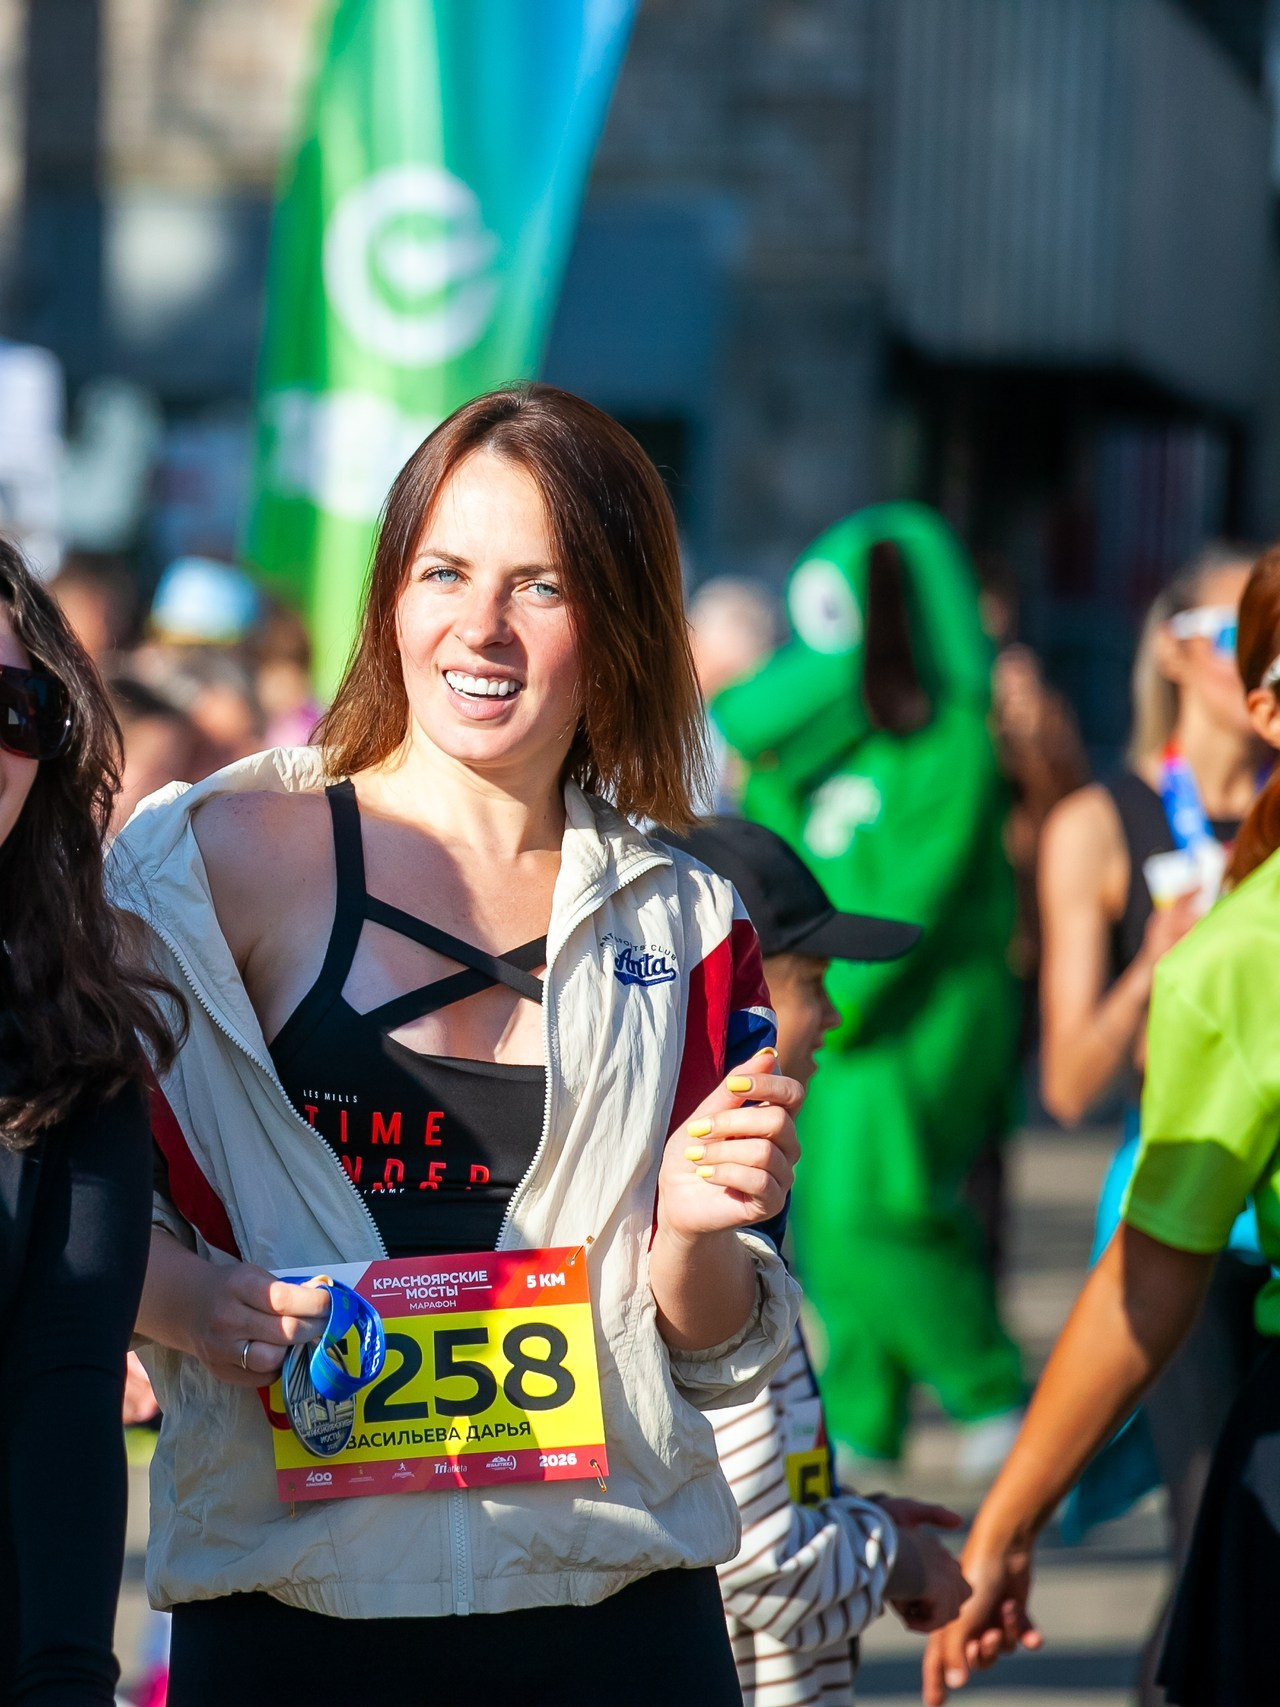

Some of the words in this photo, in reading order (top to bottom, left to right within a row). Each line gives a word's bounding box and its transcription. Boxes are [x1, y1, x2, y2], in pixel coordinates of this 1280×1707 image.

[650, 944, 677, 961] CLUB
[324, 1092, 358, 1103] MILLS
[304, 1104, 445, 1146] TIME
[373, 1270, 488, 1290] КРАСНОЯРСКИЕ
[526, 1275, 537, 1289] 5
[539, 1272, 566, 1287] КМ
[405, 1285, 459, 1300] МОСТЫ
[409, 1300, 457, 1311] МАРАФОН
[336, 1322, 576, 1424] 258
[346, 1426, 461, 1450] ВАСИЛЬЕВА
[466, 1421, 531, 1442] ДАРЬЯ
[539, 1453, 577, 1467] 2026
[306, 1470, 332, 1483] 400
